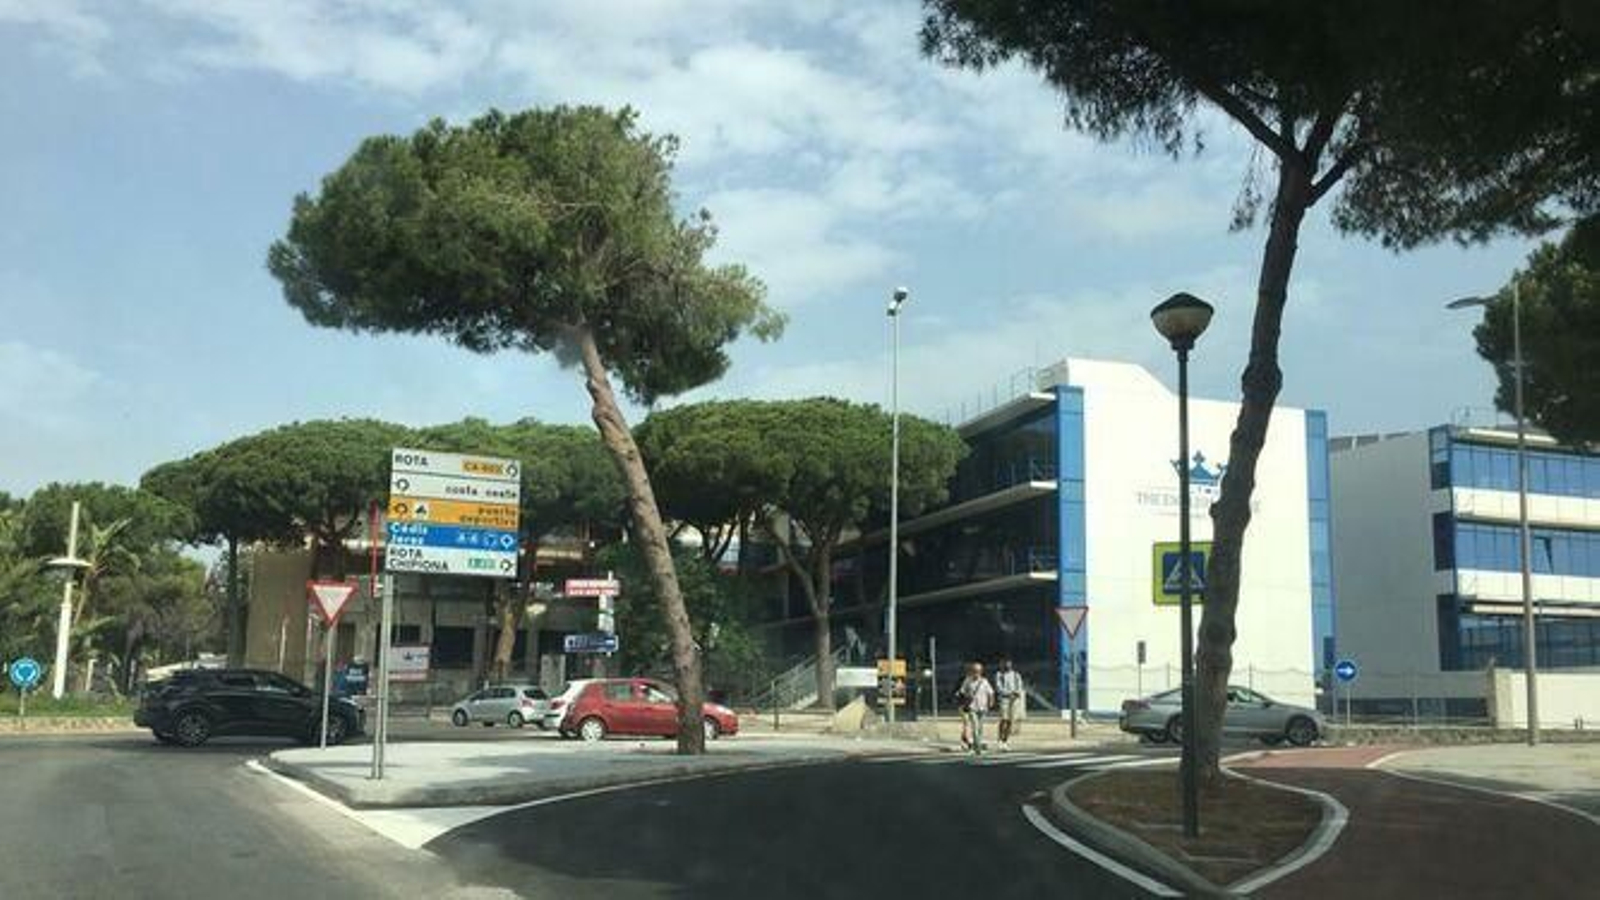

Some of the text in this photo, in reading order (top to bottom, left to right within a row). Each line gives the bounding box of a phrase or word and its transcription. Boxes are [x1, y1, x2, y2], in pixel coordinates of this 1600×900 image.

[394, 454, 429, 466] ROTA
[389, 547, 423, 558] ROTA
[389, 557, 449, 572] CHIPIONA
